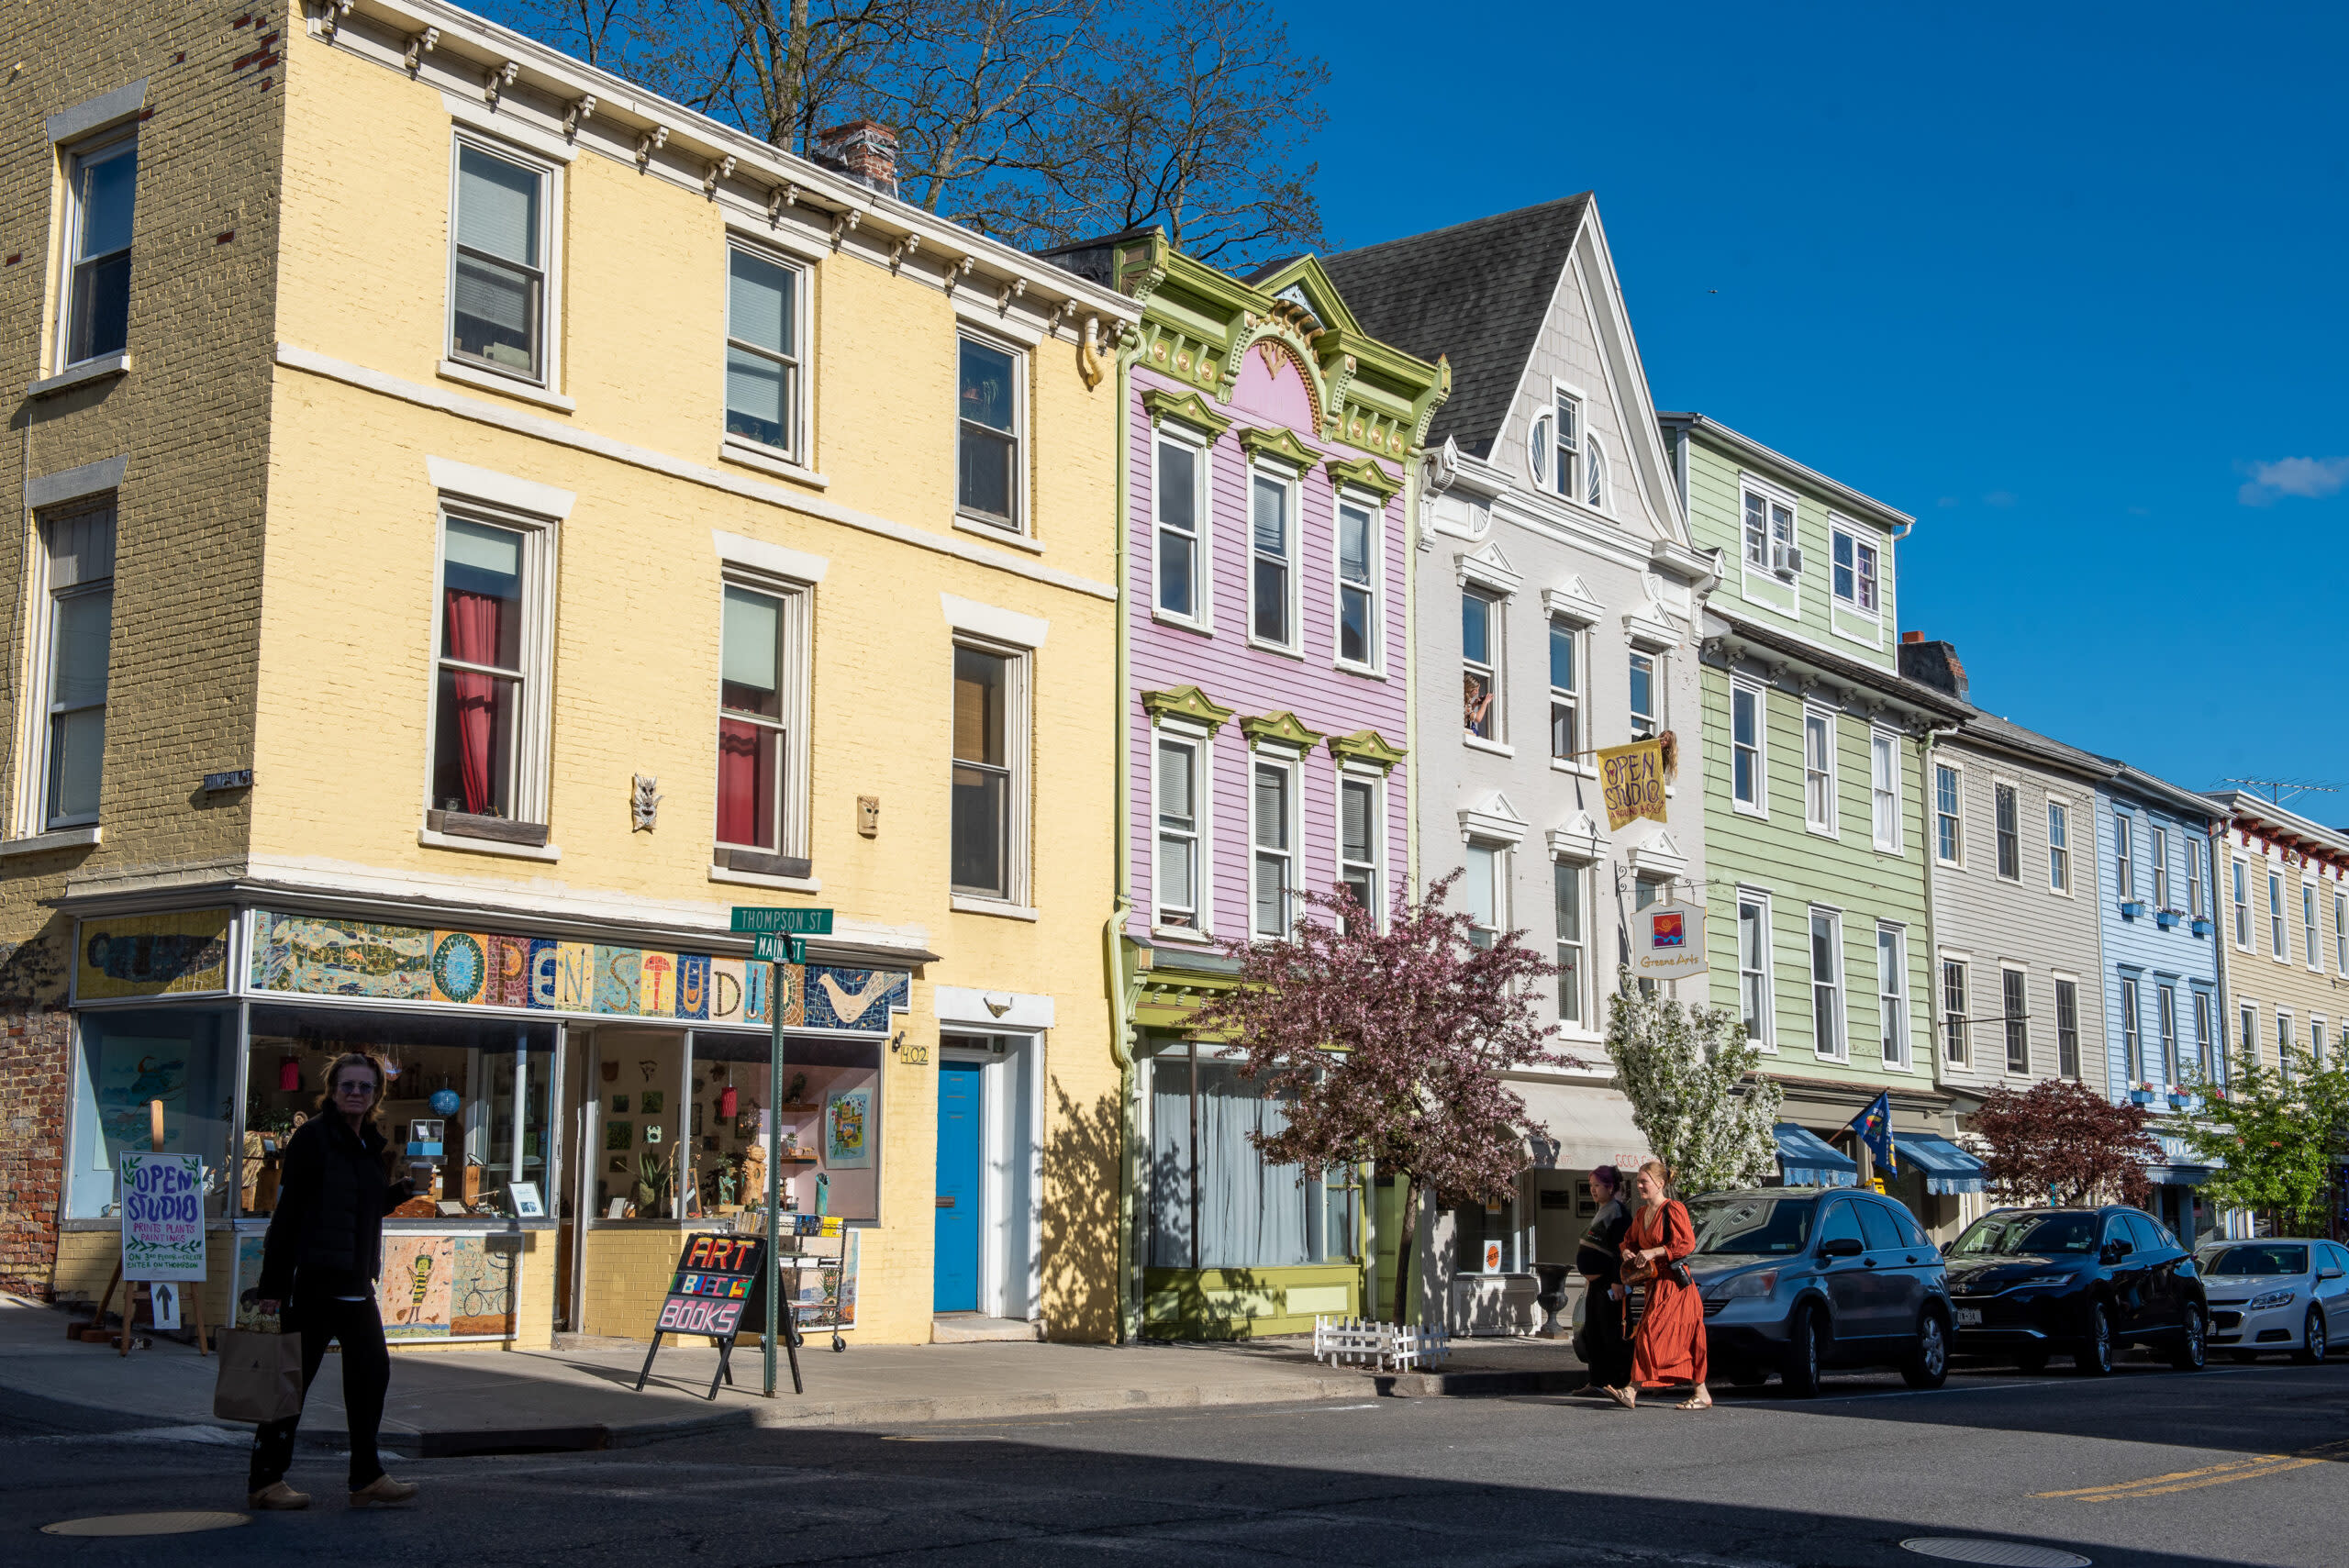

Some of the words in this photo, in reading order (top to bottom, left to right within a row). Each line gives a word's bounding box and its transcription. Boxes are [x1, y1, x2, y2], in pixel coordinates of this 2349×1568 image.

[1605, 752, 1654, 785] OPEN
[1605, 779, 1660, 810] STUDIO
[1610, 806, 1638, 820] AROUND
[741, 910, 804, 930] THOMPSON
[809, 911, 823, 930] ST
[758, 937, 784, 958] MAIN
[1640, 955, 1675, 968] Greene
[1676, 952, 1699, 965] Arts
[433, 932, 586, 1006] OPEN
[602, 953, 796, 1019] STUDIO
[902, 1046, 929, 1062] 402
[1615, 1153, 1641, 1168] GCCA
[136, 1164, 193, 1195] OPEN
[128, 1192, 198, 1224] STUDIO
[133, 1222, 161, 1234] PRINTS
[165, 1223, 195, 1235] PLANTS
[140, 1233, 186, 1243] PAINTINGS
[128, 1252, 140, 1262] ON
[157, 1253, 177, 1262] FLOOR
[687, 1237, 756, 1270] ART
[668, 1273, 753, 1299] OBJECTS
[659, 1298, 741, 1333] BOOKS
